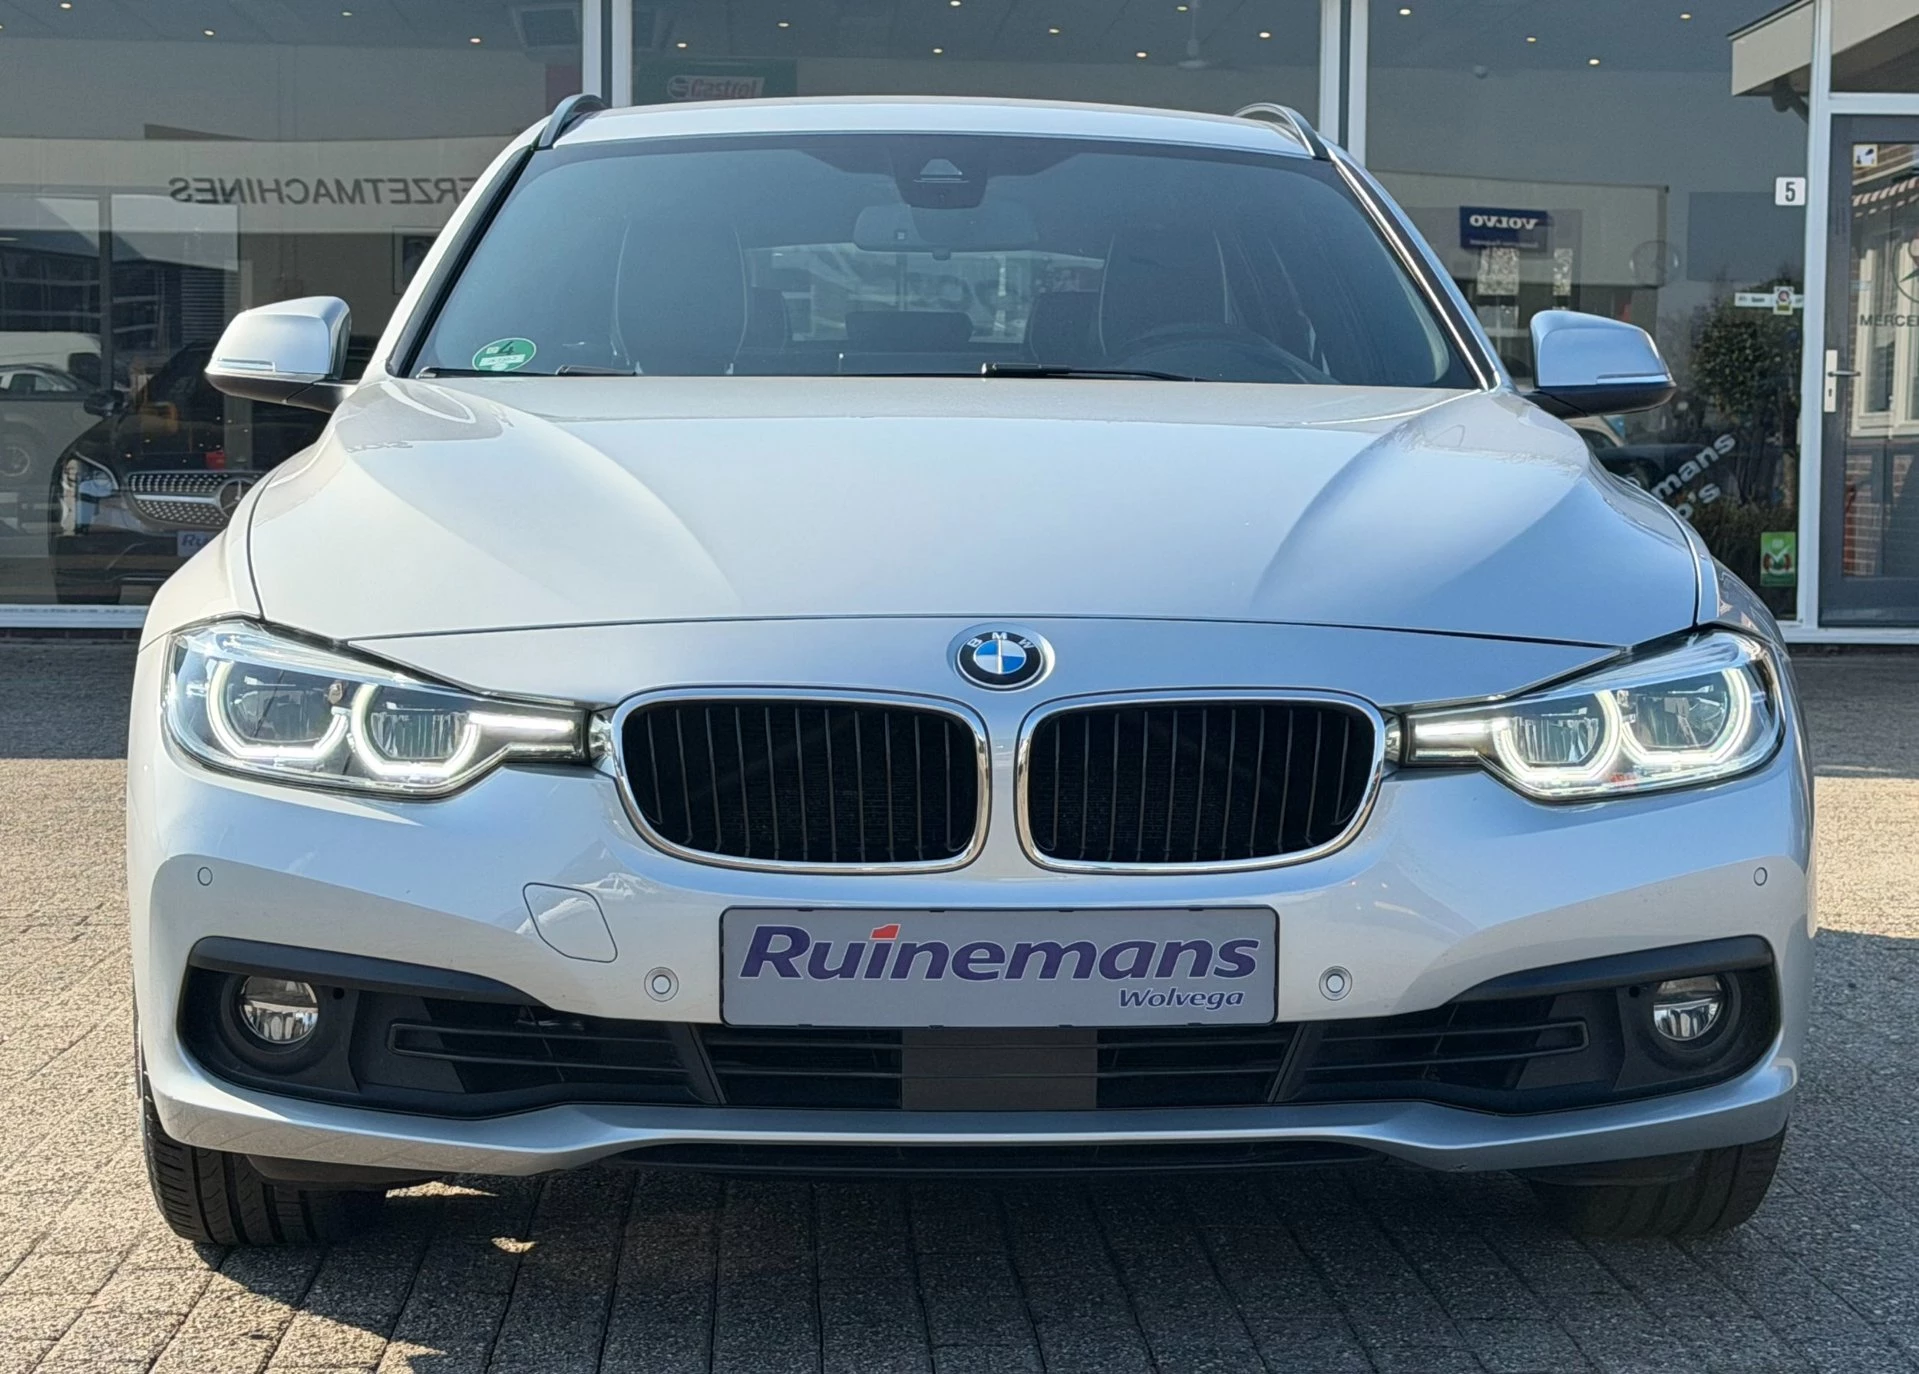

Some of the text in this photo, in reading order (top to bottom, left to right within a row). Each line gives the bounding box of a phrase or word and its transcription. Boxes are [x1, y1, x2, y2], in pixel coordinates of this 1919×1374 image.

[691, 78, 758, 98] Castrol
[1785, 181, 1796, 202] 5
[1860, 314, 1919, 327] MERCE
[967, 632, 1035, 649] BMW
[738, 922, 1261, 981] Ruinemans
[1117, 986, 1245, 1011] Wolvega
